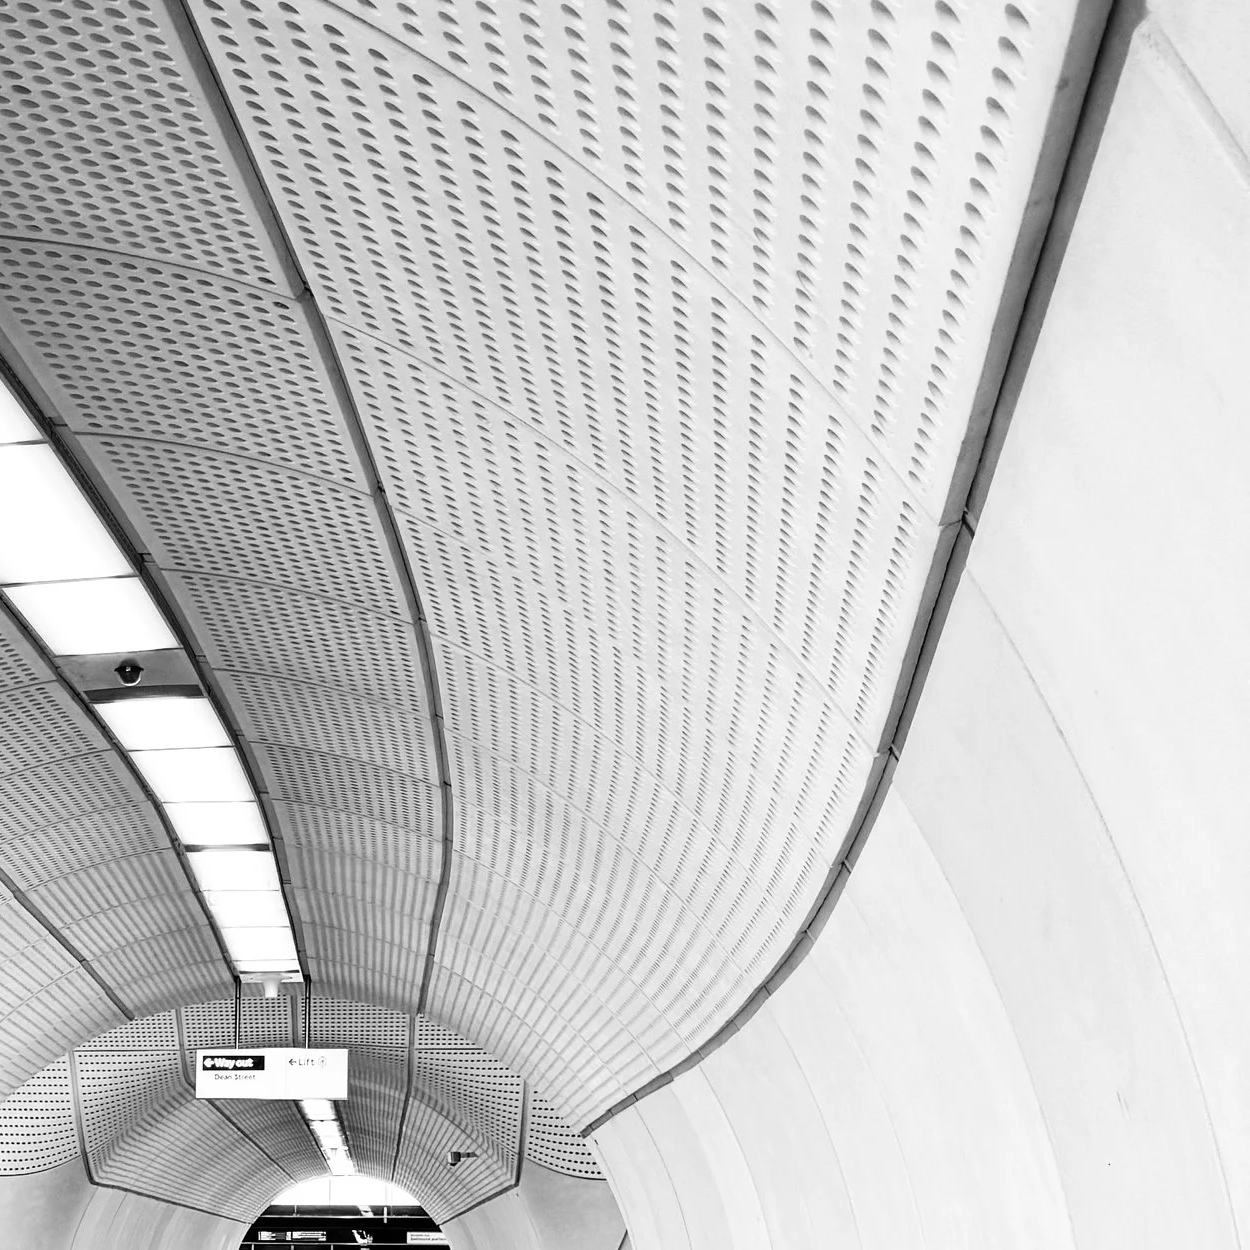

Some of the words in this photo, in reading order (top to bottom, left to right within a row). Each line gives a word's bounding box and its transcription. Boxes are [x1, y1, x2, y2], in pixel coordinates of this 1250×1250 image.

[214, 1057, 235, 1069] Way
[235, 1058, 254, 1067] out
[298, 1058, 315, 1066] Lift
